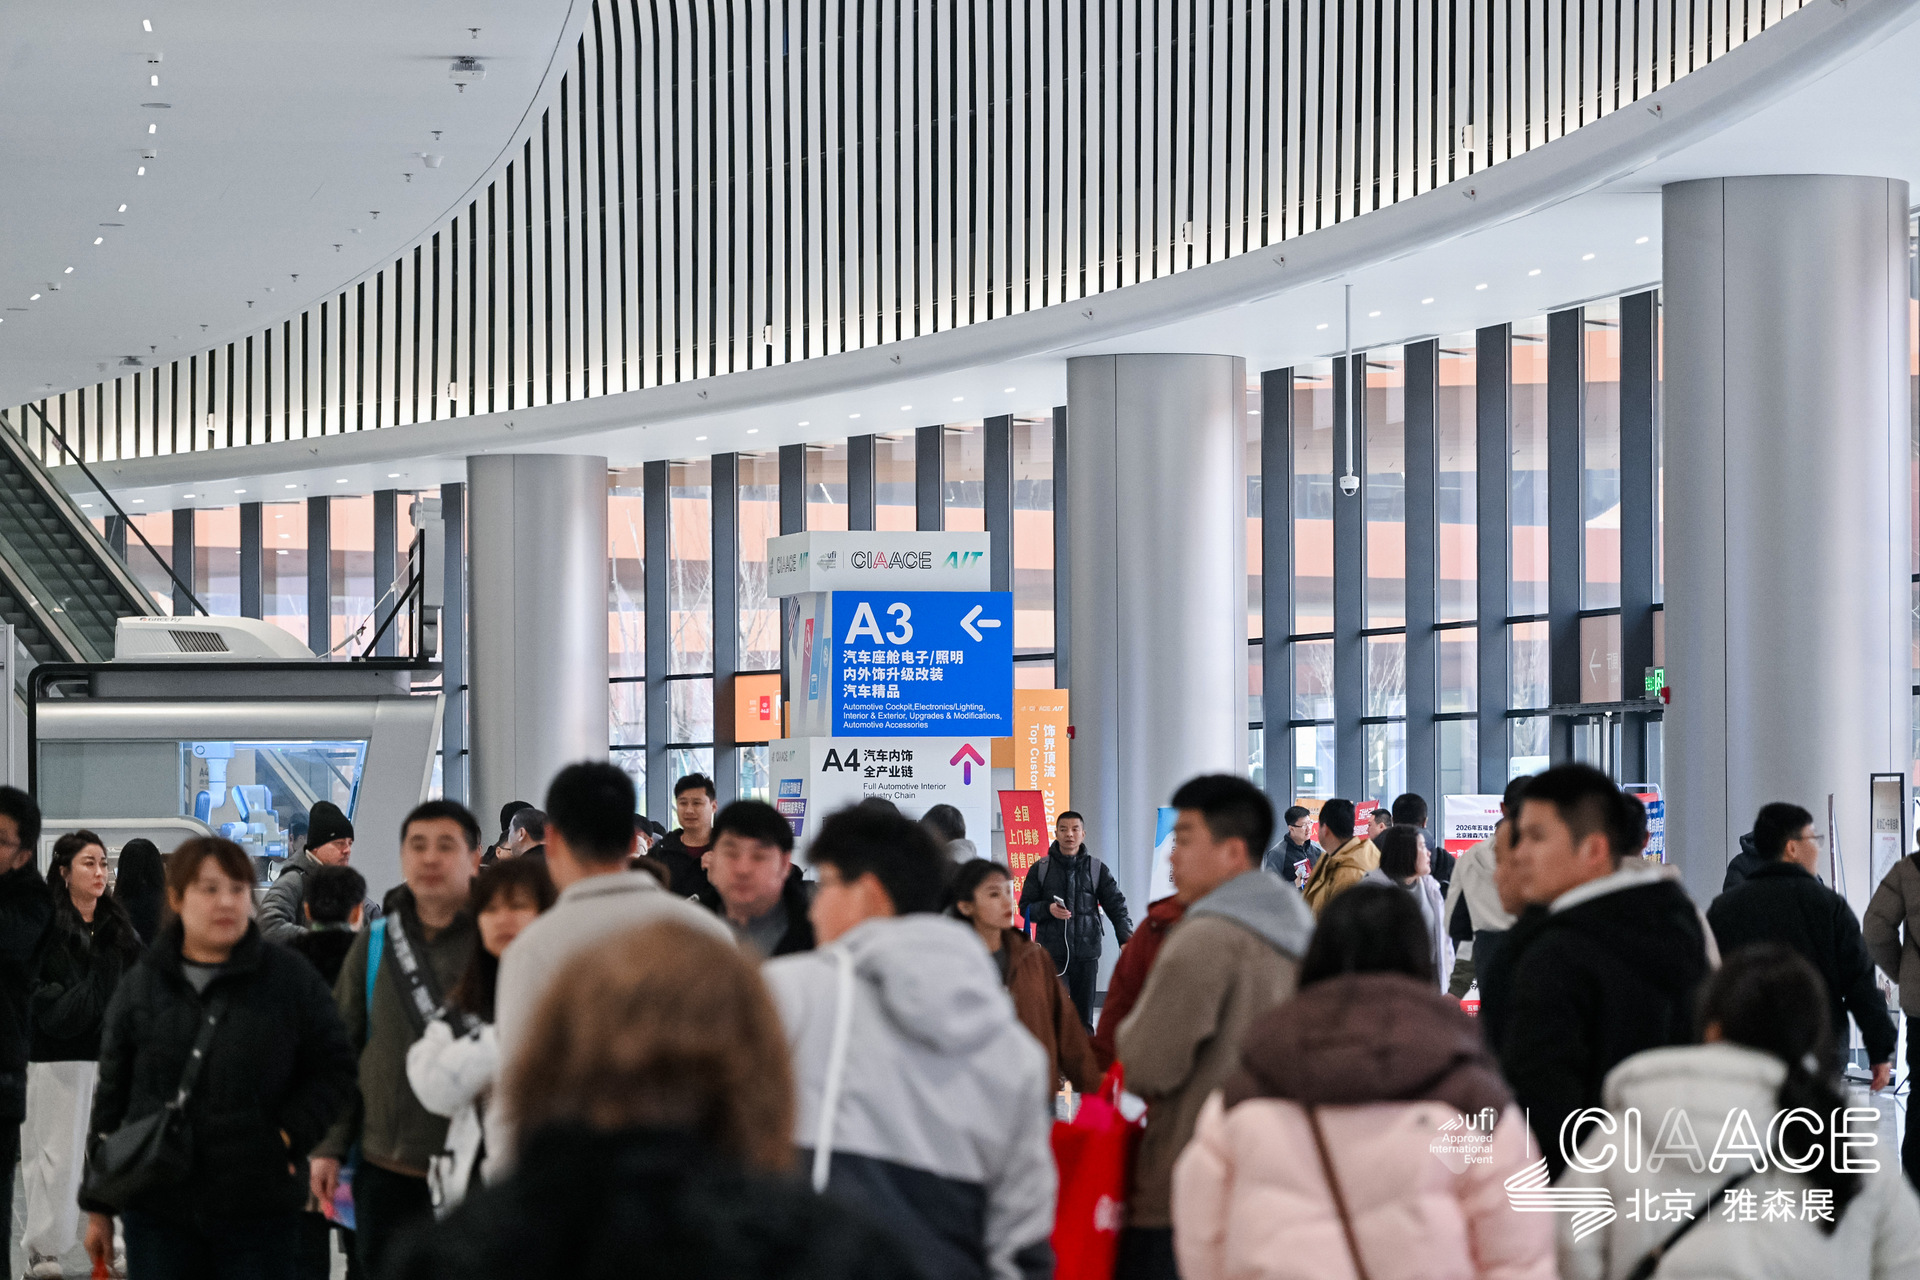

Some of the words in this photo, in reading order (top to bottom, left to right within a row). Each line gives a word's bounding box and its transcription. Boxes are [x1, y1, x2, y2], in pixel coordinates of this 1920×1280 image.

[851, 551, 932, 569] CIAACE
[941, 551, 984, 569] AIT
[844, 602, 914, 645] A3
[843, 649, 964, 666] 汽车座舱电子/照明
[843, 667, 944, 682] 内外饰升级改装
[843, 684, 900, 698] 汽车精品
[843, 703, 884, 711] Automotive
[843, 712, 869, 720] Interior
[870, 712, 876, 720] &
[877, 712, 908, 721] Exterior,
[909, 712, 944, 721] Upgrades
[946, 712, 952, 720] &
[953, 712, 1003, 721] Modifications,
[843, 721, 884, 729] Automotive
[885, 721, 929, 729] Accessories
[1028, 723, 1040, 745] Top
[822, 748, 861, 772] A4
[863, 749, 913, 762] 汽车内饰
[863, 765, 914, 778] 全产业链
[863, 792, 892, 800] Industry
[1014, 805, 1030, 822] 全国
[1009, 829, 1039, 846] 上门维修
